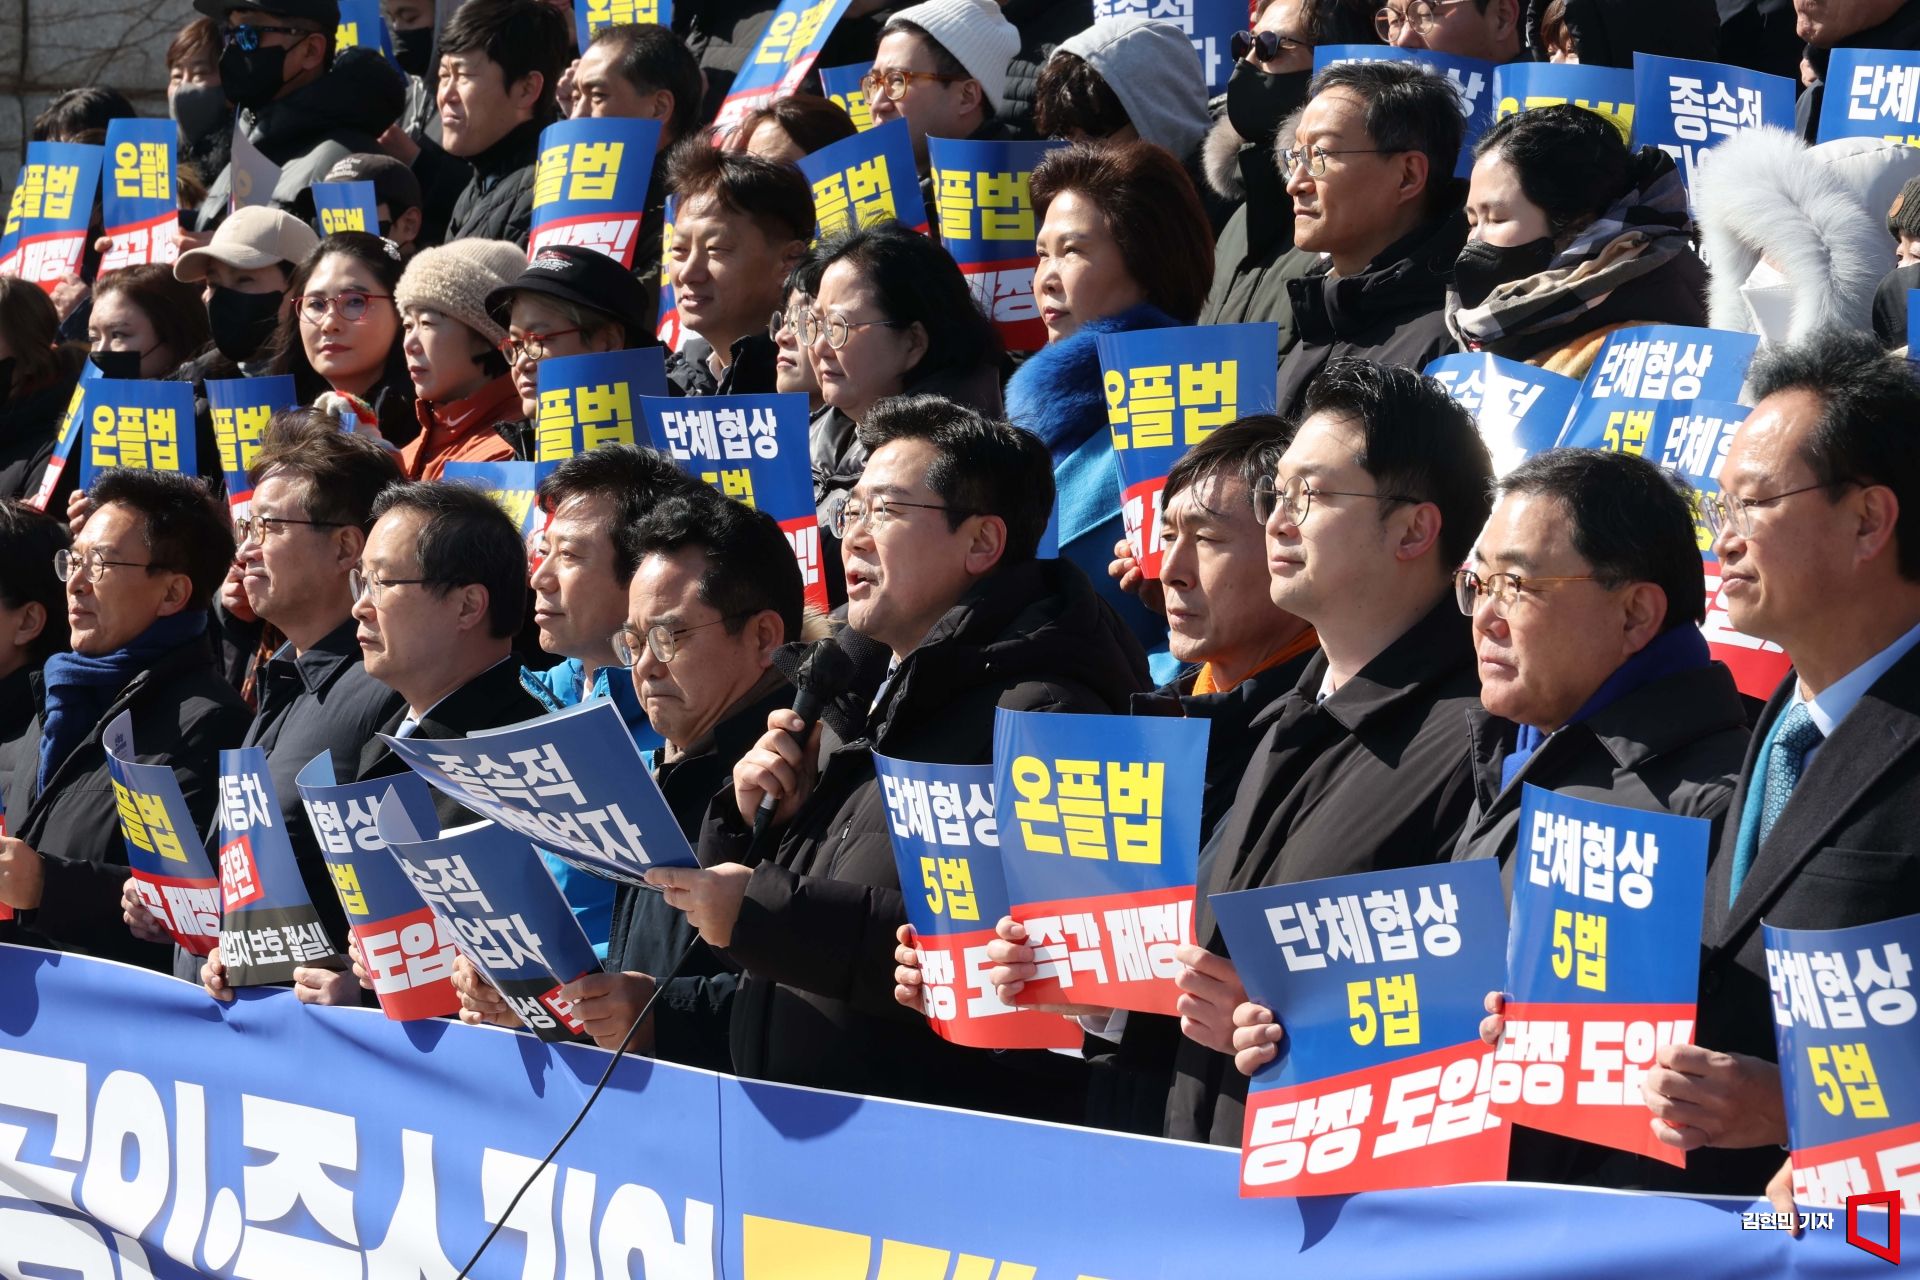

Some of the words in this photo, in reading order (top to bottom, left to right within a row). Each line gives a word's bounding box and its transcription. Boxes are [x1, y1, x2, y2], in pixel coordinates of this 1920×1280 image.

[1848, 65, 1920, 123] 단체
[114, 142, 170, 199] 온플법
[533, 143, 624, 210] 플법
[811, 155, 896, 240] 플법
[1591, 340, 1713, 400] 단체협상
[91, 405, 178, 471] 온플법
[211, 406, 272, 471] 플법
[535, 382, 634, 463] 플법
[661, 408, 778, 460] 단체협상
[1661, 415, 1744, 480] 단체협
[112, 777, 188, 863] 플법
[1011, 755, 1165, 865] 온플법
[920, 857, 980, 921] 5법
[1530, 810, 1660, 910] 단체협상
[247, 927, 290, 965] 보호
[1264, 883, 1461, 972] 단체협상
[1551, 909, 1608, 993] 5법
[963, 944, 1030, 1019] 도
[1346, 973, 1420, 1047] 5법
[1765, 943, 1917, 1029] 단체협상
[1489, 1020, 1570, 1105] 당장
[1807, 1043, 1890, 1119] 5법
[1243, 1083, 1373, 1186] 당장
